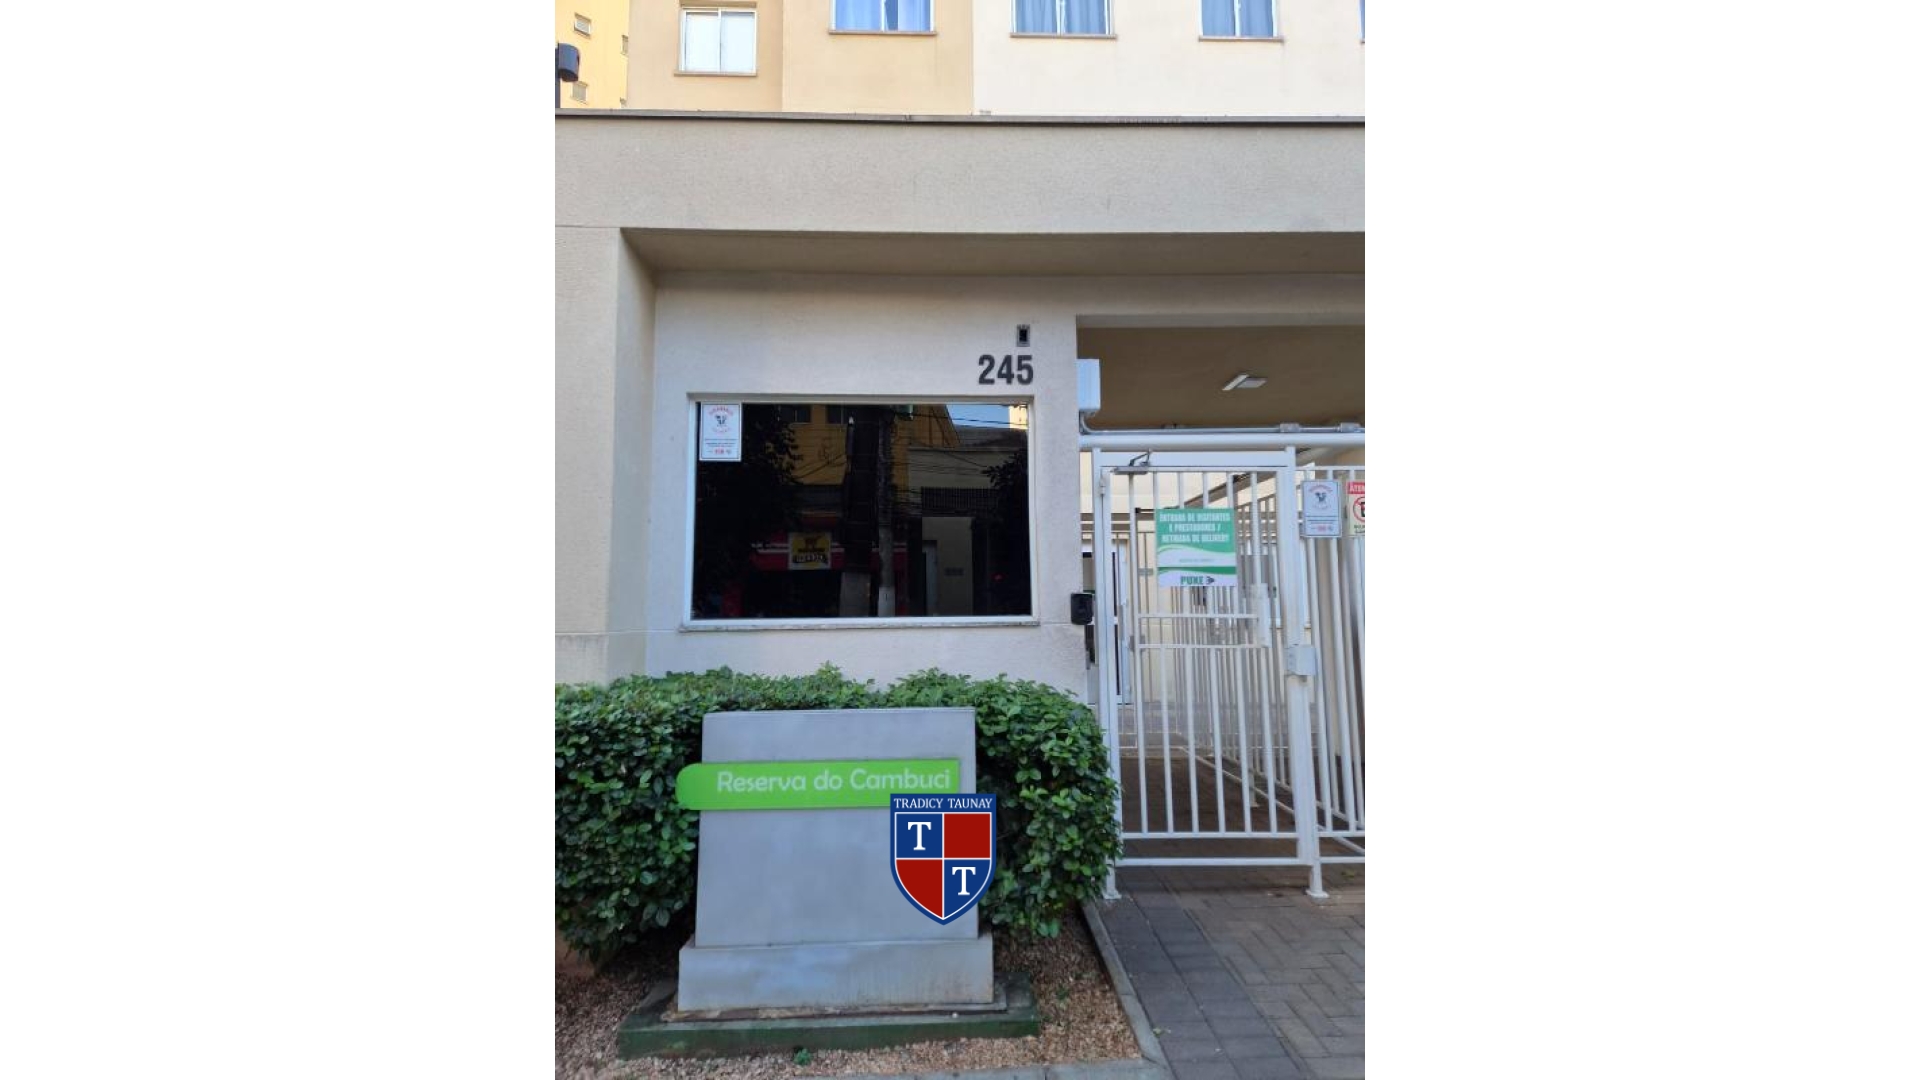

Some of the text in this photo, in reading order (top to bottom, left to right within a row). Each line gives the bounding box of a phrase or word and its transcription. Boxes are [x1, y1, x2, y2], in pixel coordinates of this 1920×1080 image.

[978, 354, 1034, 385] 245
[1159, 512, 1231, 522] ENTRADA DE VISITANTES
[1168, 523, 1173, 533] E
[1174, 523, 1216, 532] PRESTADORES
[1161, 533, 1230, 543] RETIRADA DE DELIVERY
[716, 767, 951, 793] Reserva do Cambuci
